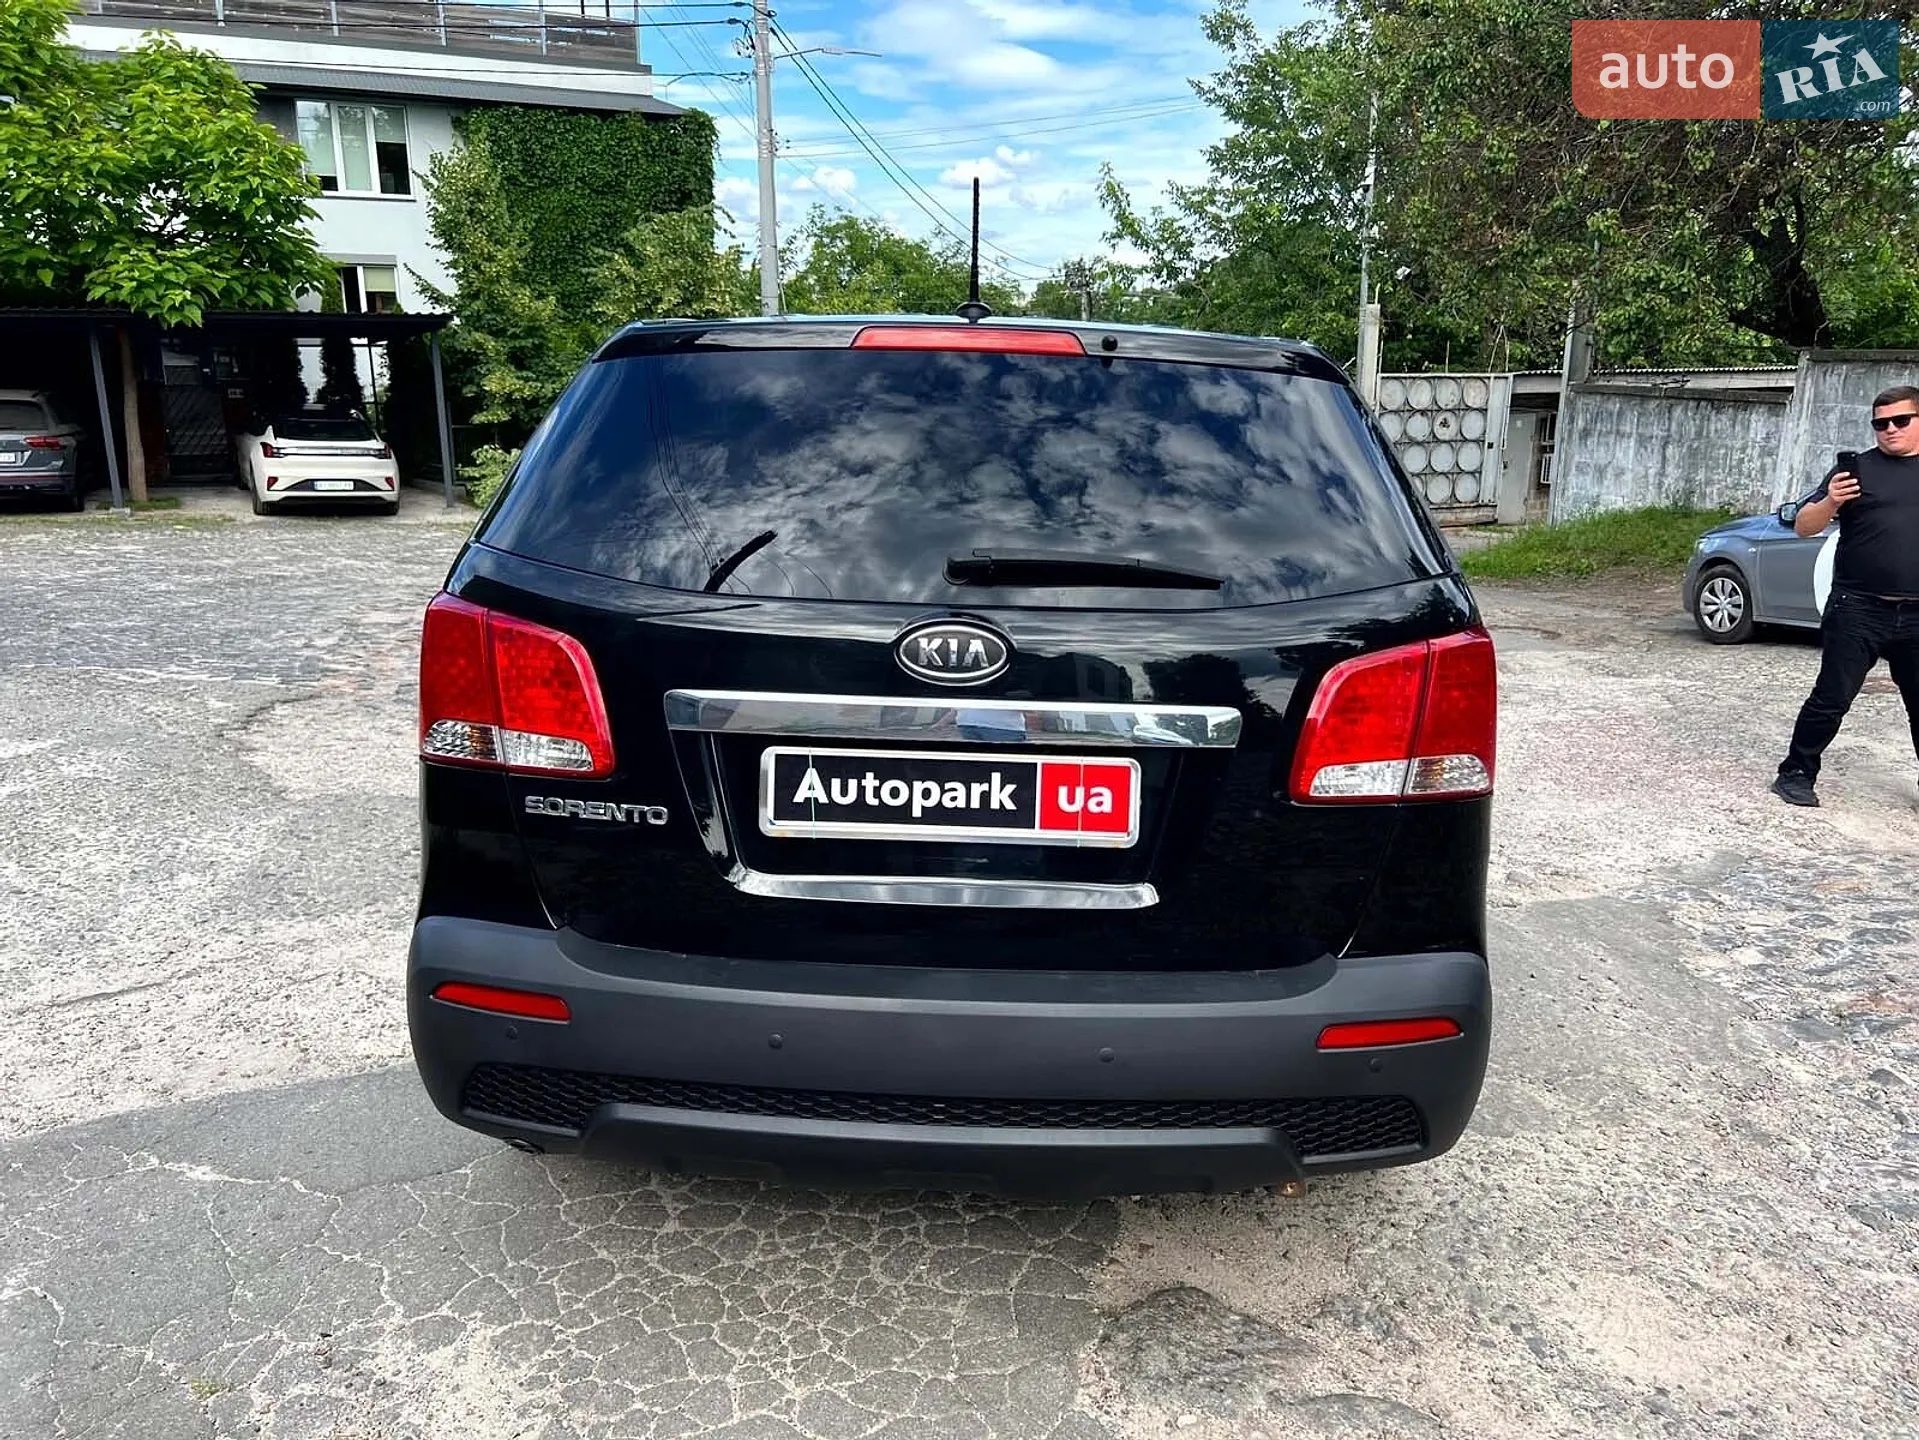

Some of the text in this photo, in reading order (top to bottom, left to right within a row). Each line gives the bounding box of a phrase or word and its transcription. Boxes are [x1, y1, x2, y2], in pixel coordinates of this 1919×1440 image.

[917, 637, 990, 668] KIA
[792, 767, 1113, 818] Autopark ua
[524, 795, 669, 826] SORENTO
